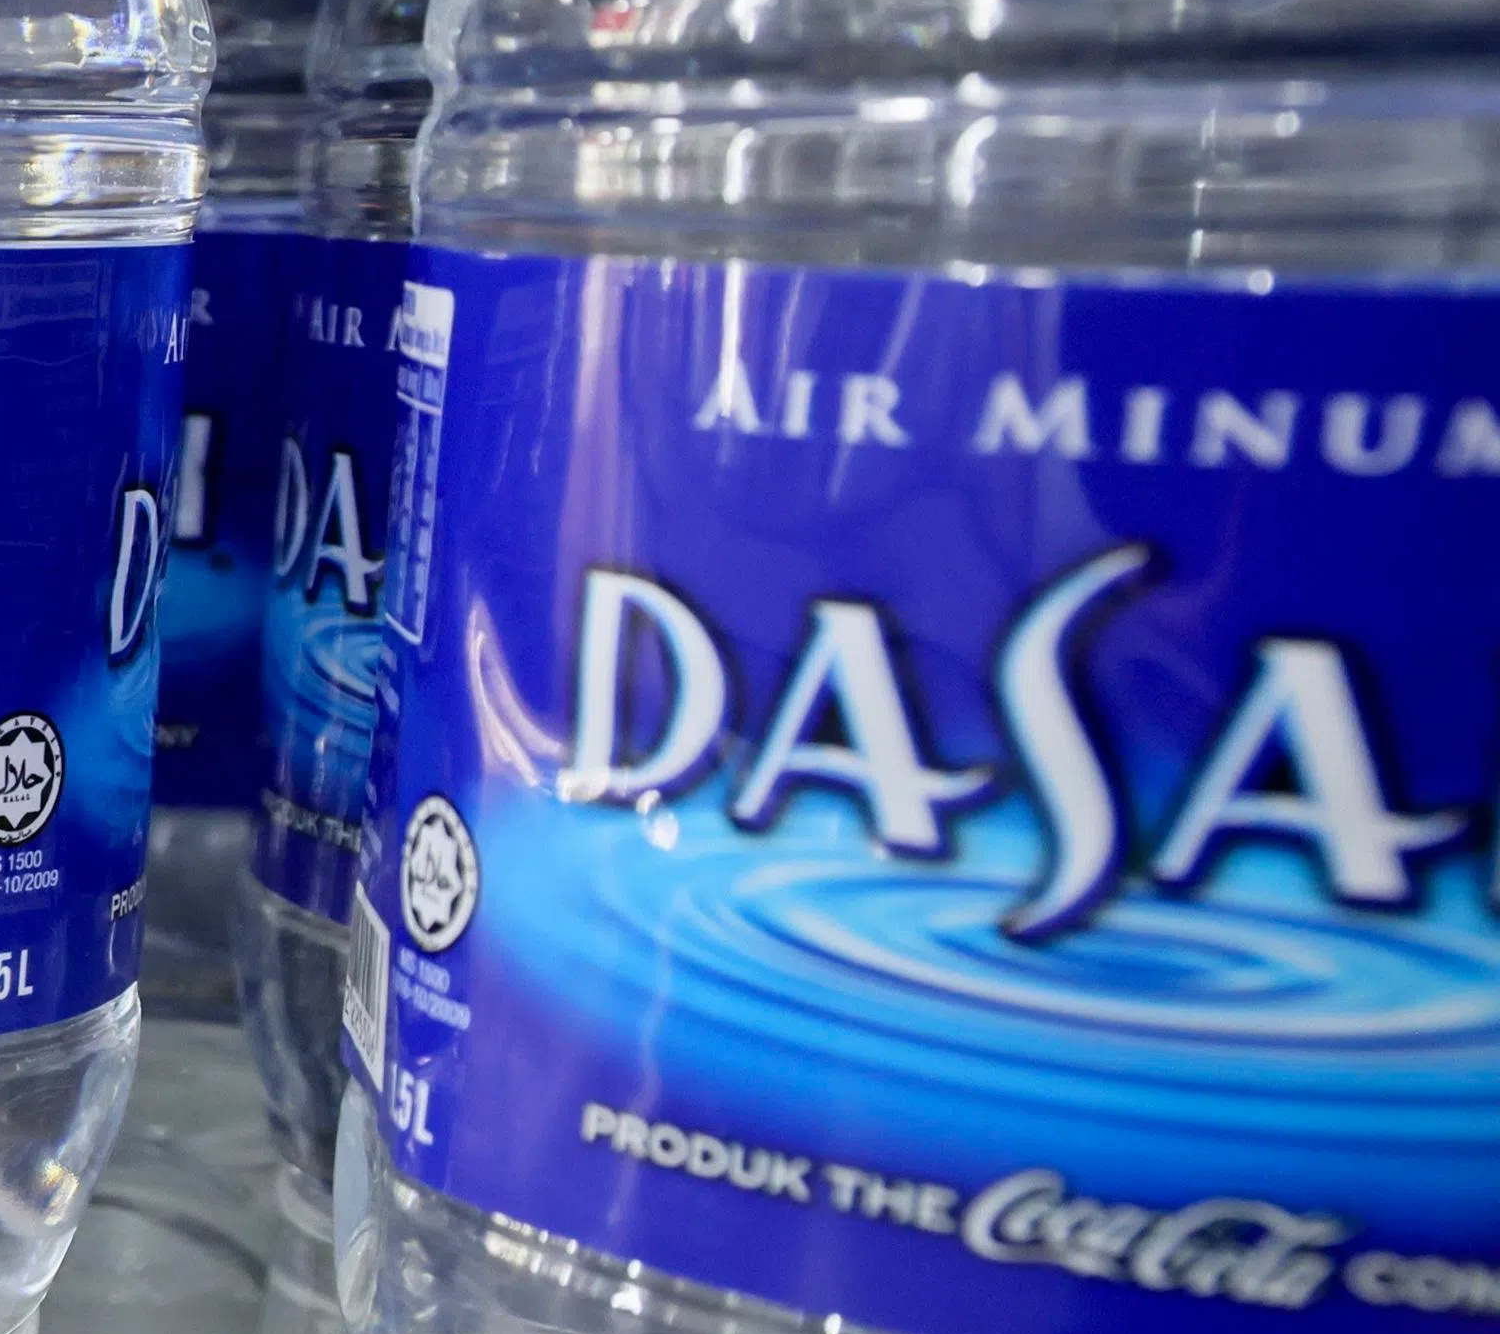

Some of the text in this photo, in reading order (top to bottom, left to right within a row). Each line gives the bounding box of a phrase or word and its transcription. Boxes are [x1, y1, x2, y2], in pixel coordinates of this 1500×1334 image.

[693, 360, 909, 448] AIR
[566, 544, 1500, 936] DASA
[8, 849, 43, 872] 1500
[17, 948, 34, 997] L
[579, 1101, 811, 1204] PRODUK
[821, 1162, 960, 1236] THE
